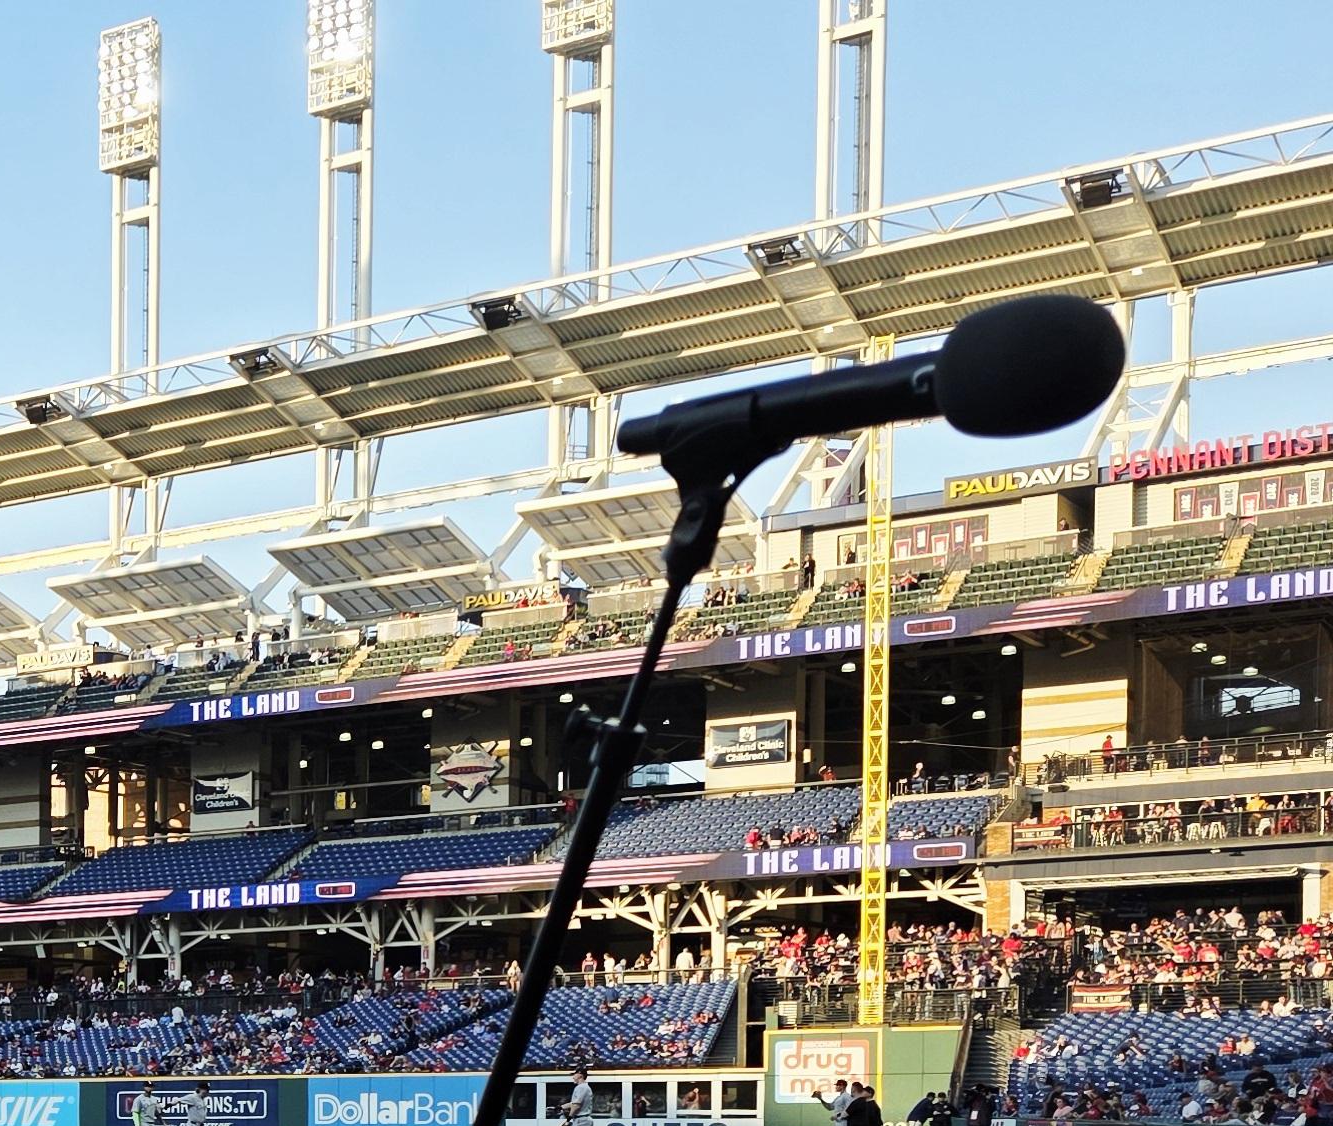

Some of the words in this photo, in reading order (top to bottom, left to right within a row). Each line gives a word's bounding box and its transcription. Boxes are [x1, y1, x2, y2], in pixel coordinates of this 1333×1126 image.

[1109, 434, 1255, 482] PENNANT
[1310, 477, 1320, 496] 2020
[1163, 581, 1230, 611] THE
[736, 632, 791, 660] THE
[192, 696, 232, 721] THE
[241, 690, 300, 715] LAND
[743, 851, 799, 875] THE
[188, 887, 231, 909] THE
[241, 883, 300, 905] LAND
[784, 1040, 852, 1075] drug
